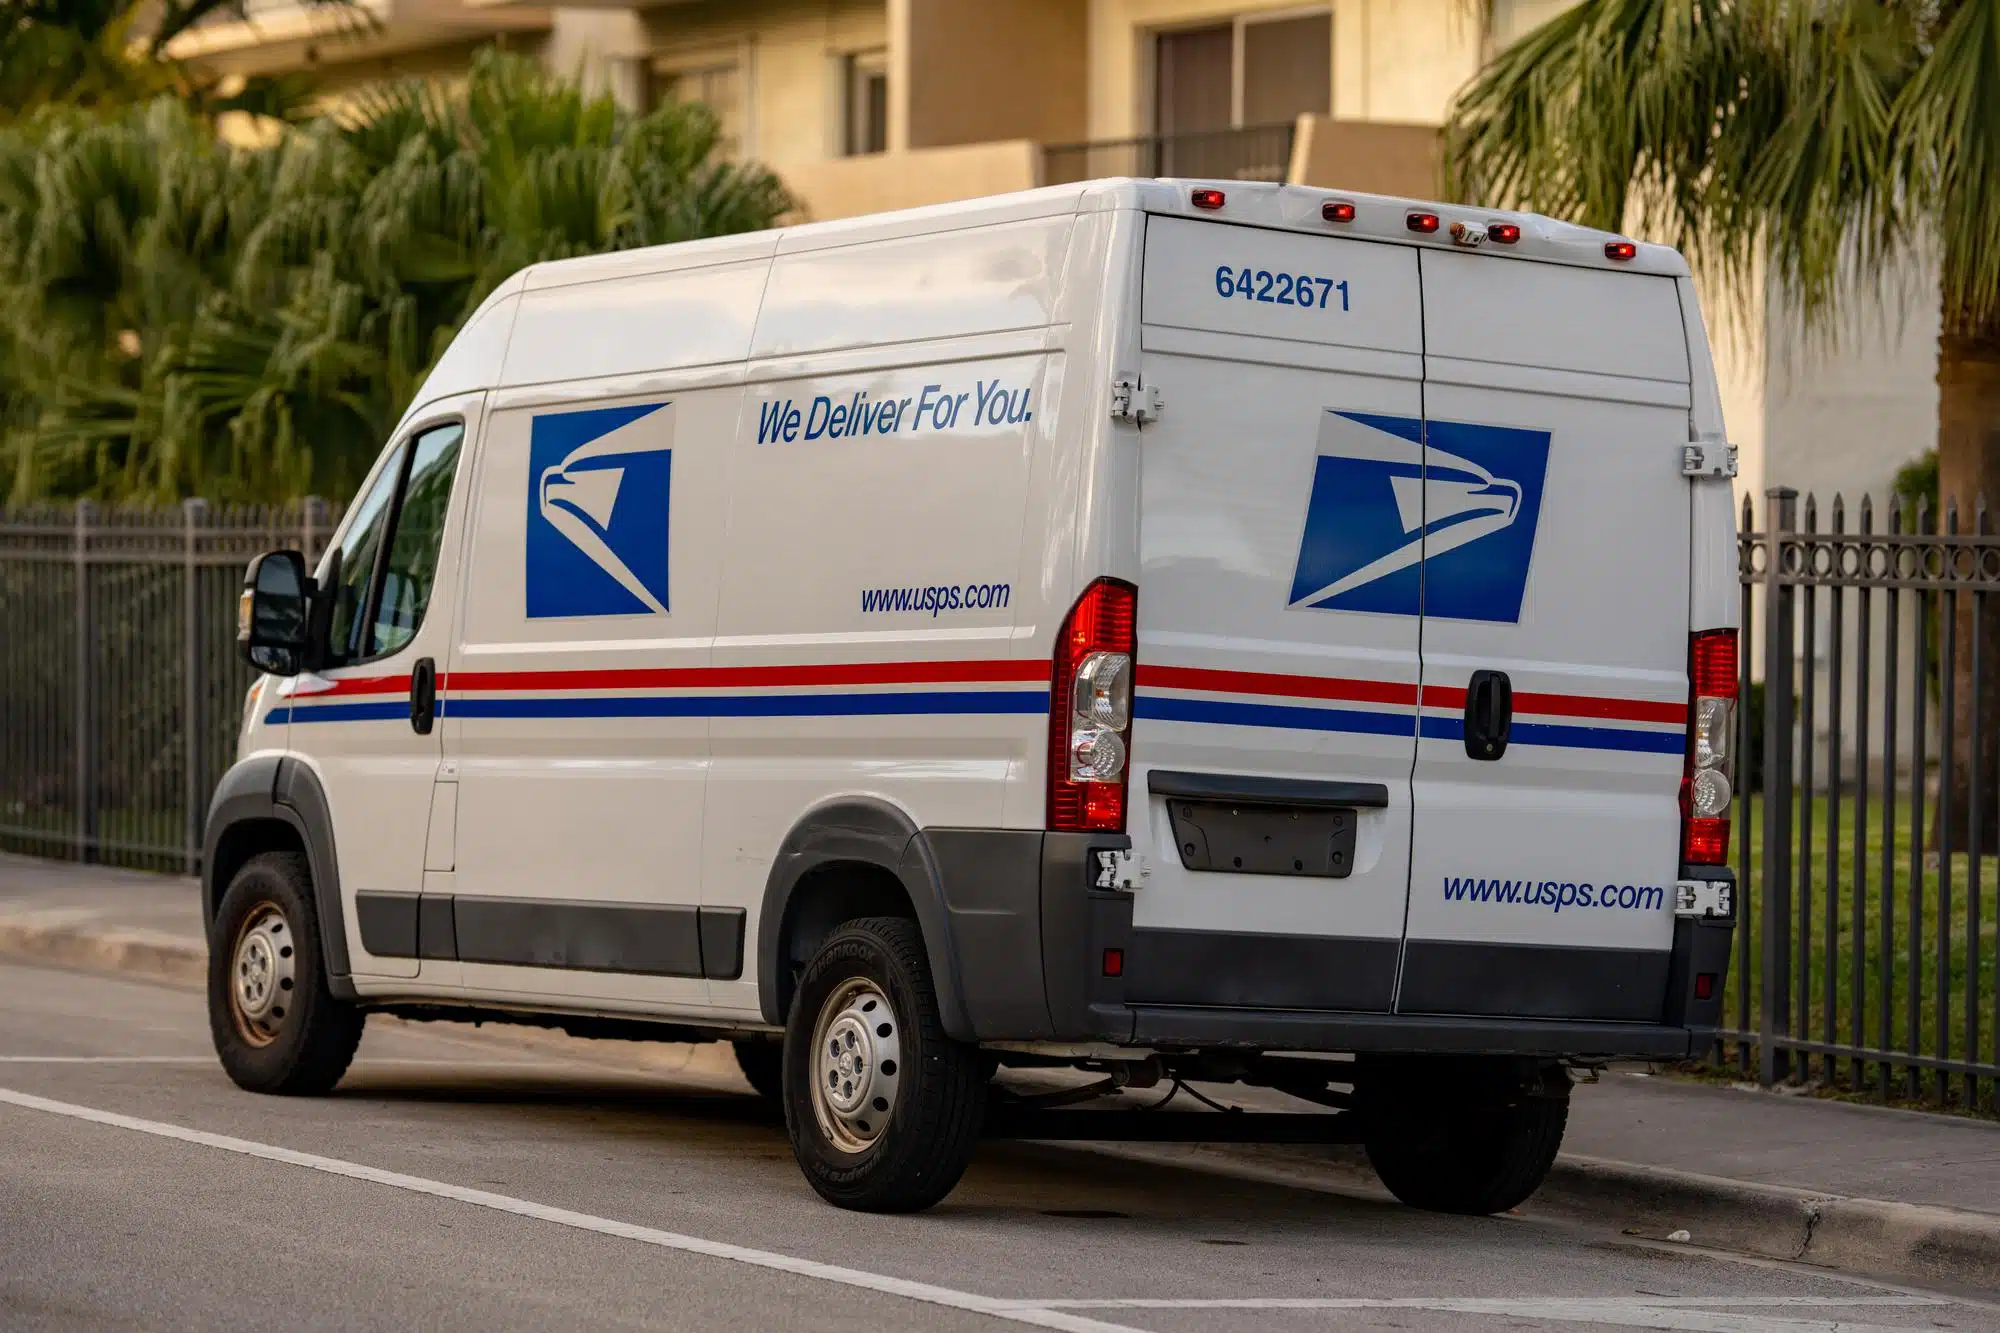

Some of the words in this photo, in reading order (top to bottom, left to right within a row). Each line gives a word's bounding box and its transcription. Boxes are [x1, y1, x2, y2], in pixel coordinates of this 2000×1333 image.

[1215, 265, 1350, 313] 6422671
[758, 399, 801, 444] We
[804, 392, 912, 441] Deliver
[911, 384, 970, 431] For
[973, 379, 1032, 426] You.
[861, 583, 1010, 617] www.usps.com
[1443, 877, 1665, 913] www.usps.com
